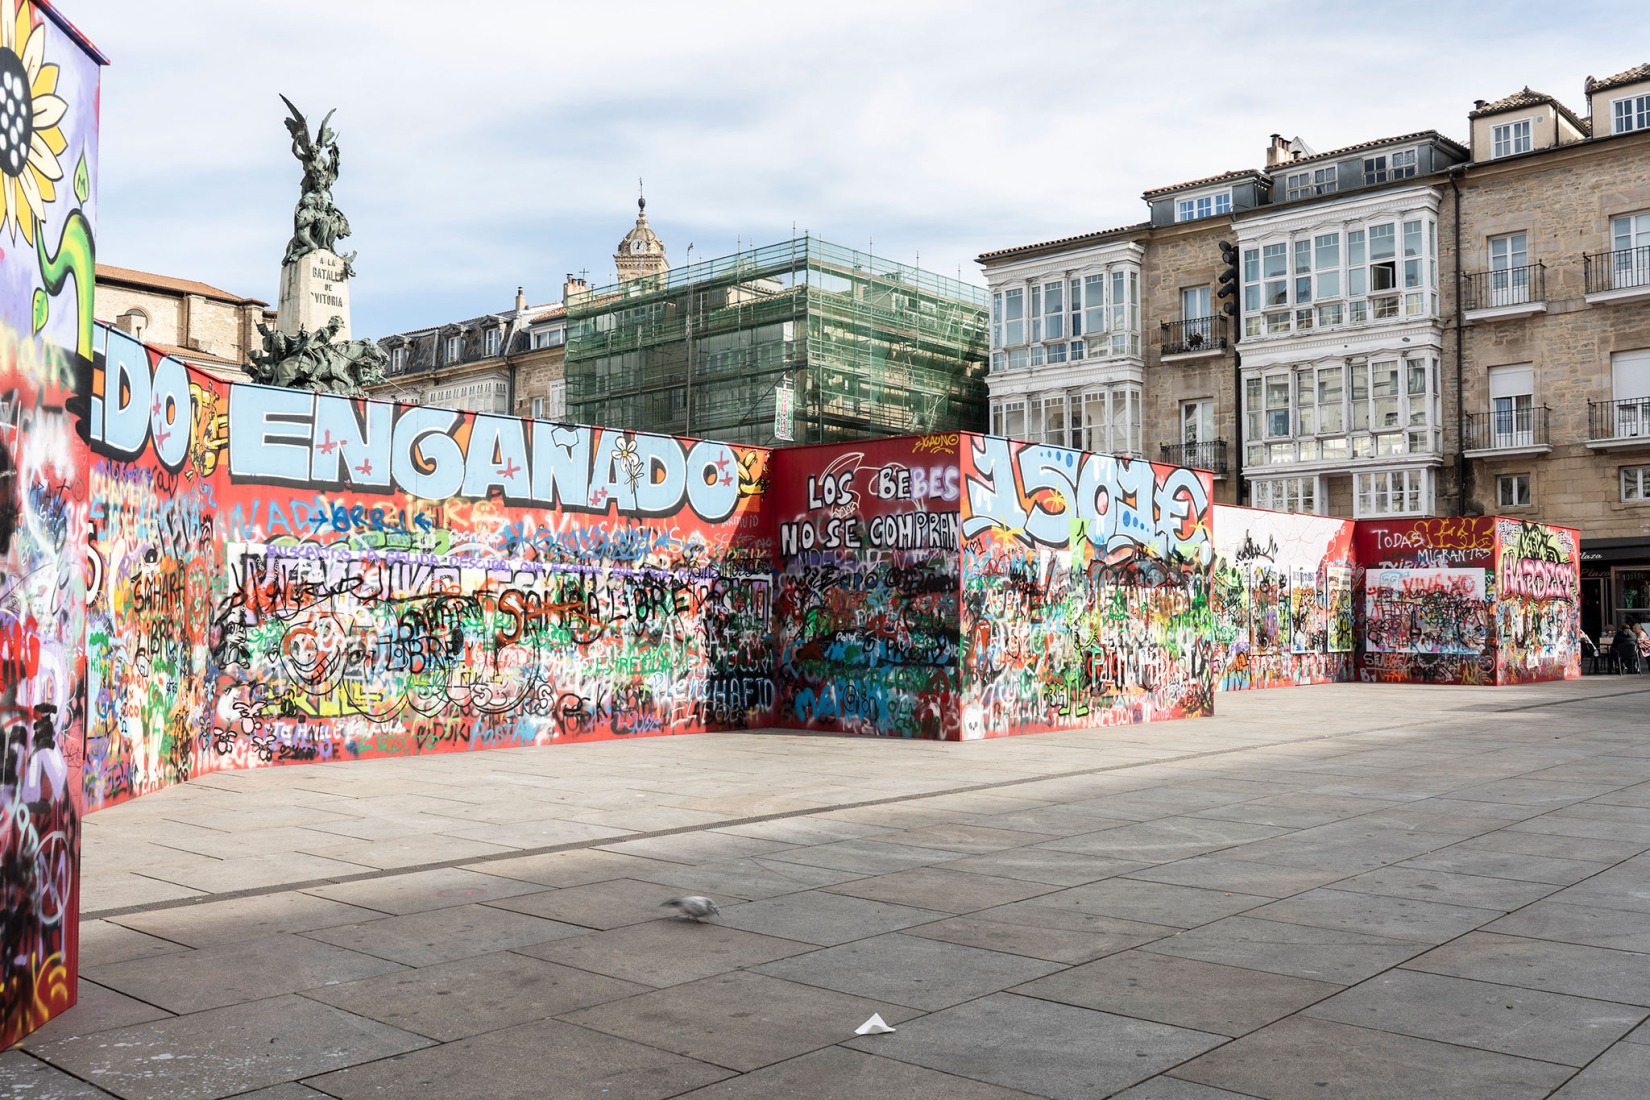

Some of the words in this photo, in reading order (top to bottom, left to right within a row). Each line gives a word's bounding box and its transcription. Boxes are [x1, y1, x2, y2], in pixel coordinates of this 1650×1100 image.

[315, 292, 343, 307] VITORIA
[228, 382, 739, 520] ENGAÑADO
[808, 470, 853, 511] LOS
[878, 466, 960, 501] BEBES
[780, 520, 815, 556] NO
[826, 516, 861, 549] SE
[869, 510, 960, 549] COMPRAN
[1370, 529, 1424, 549] TODAS
[266, 544, 352, 561] BUSCANDO
[519, 561, 543, 574] QUE
[1580, 551, 1603, 560] laza
